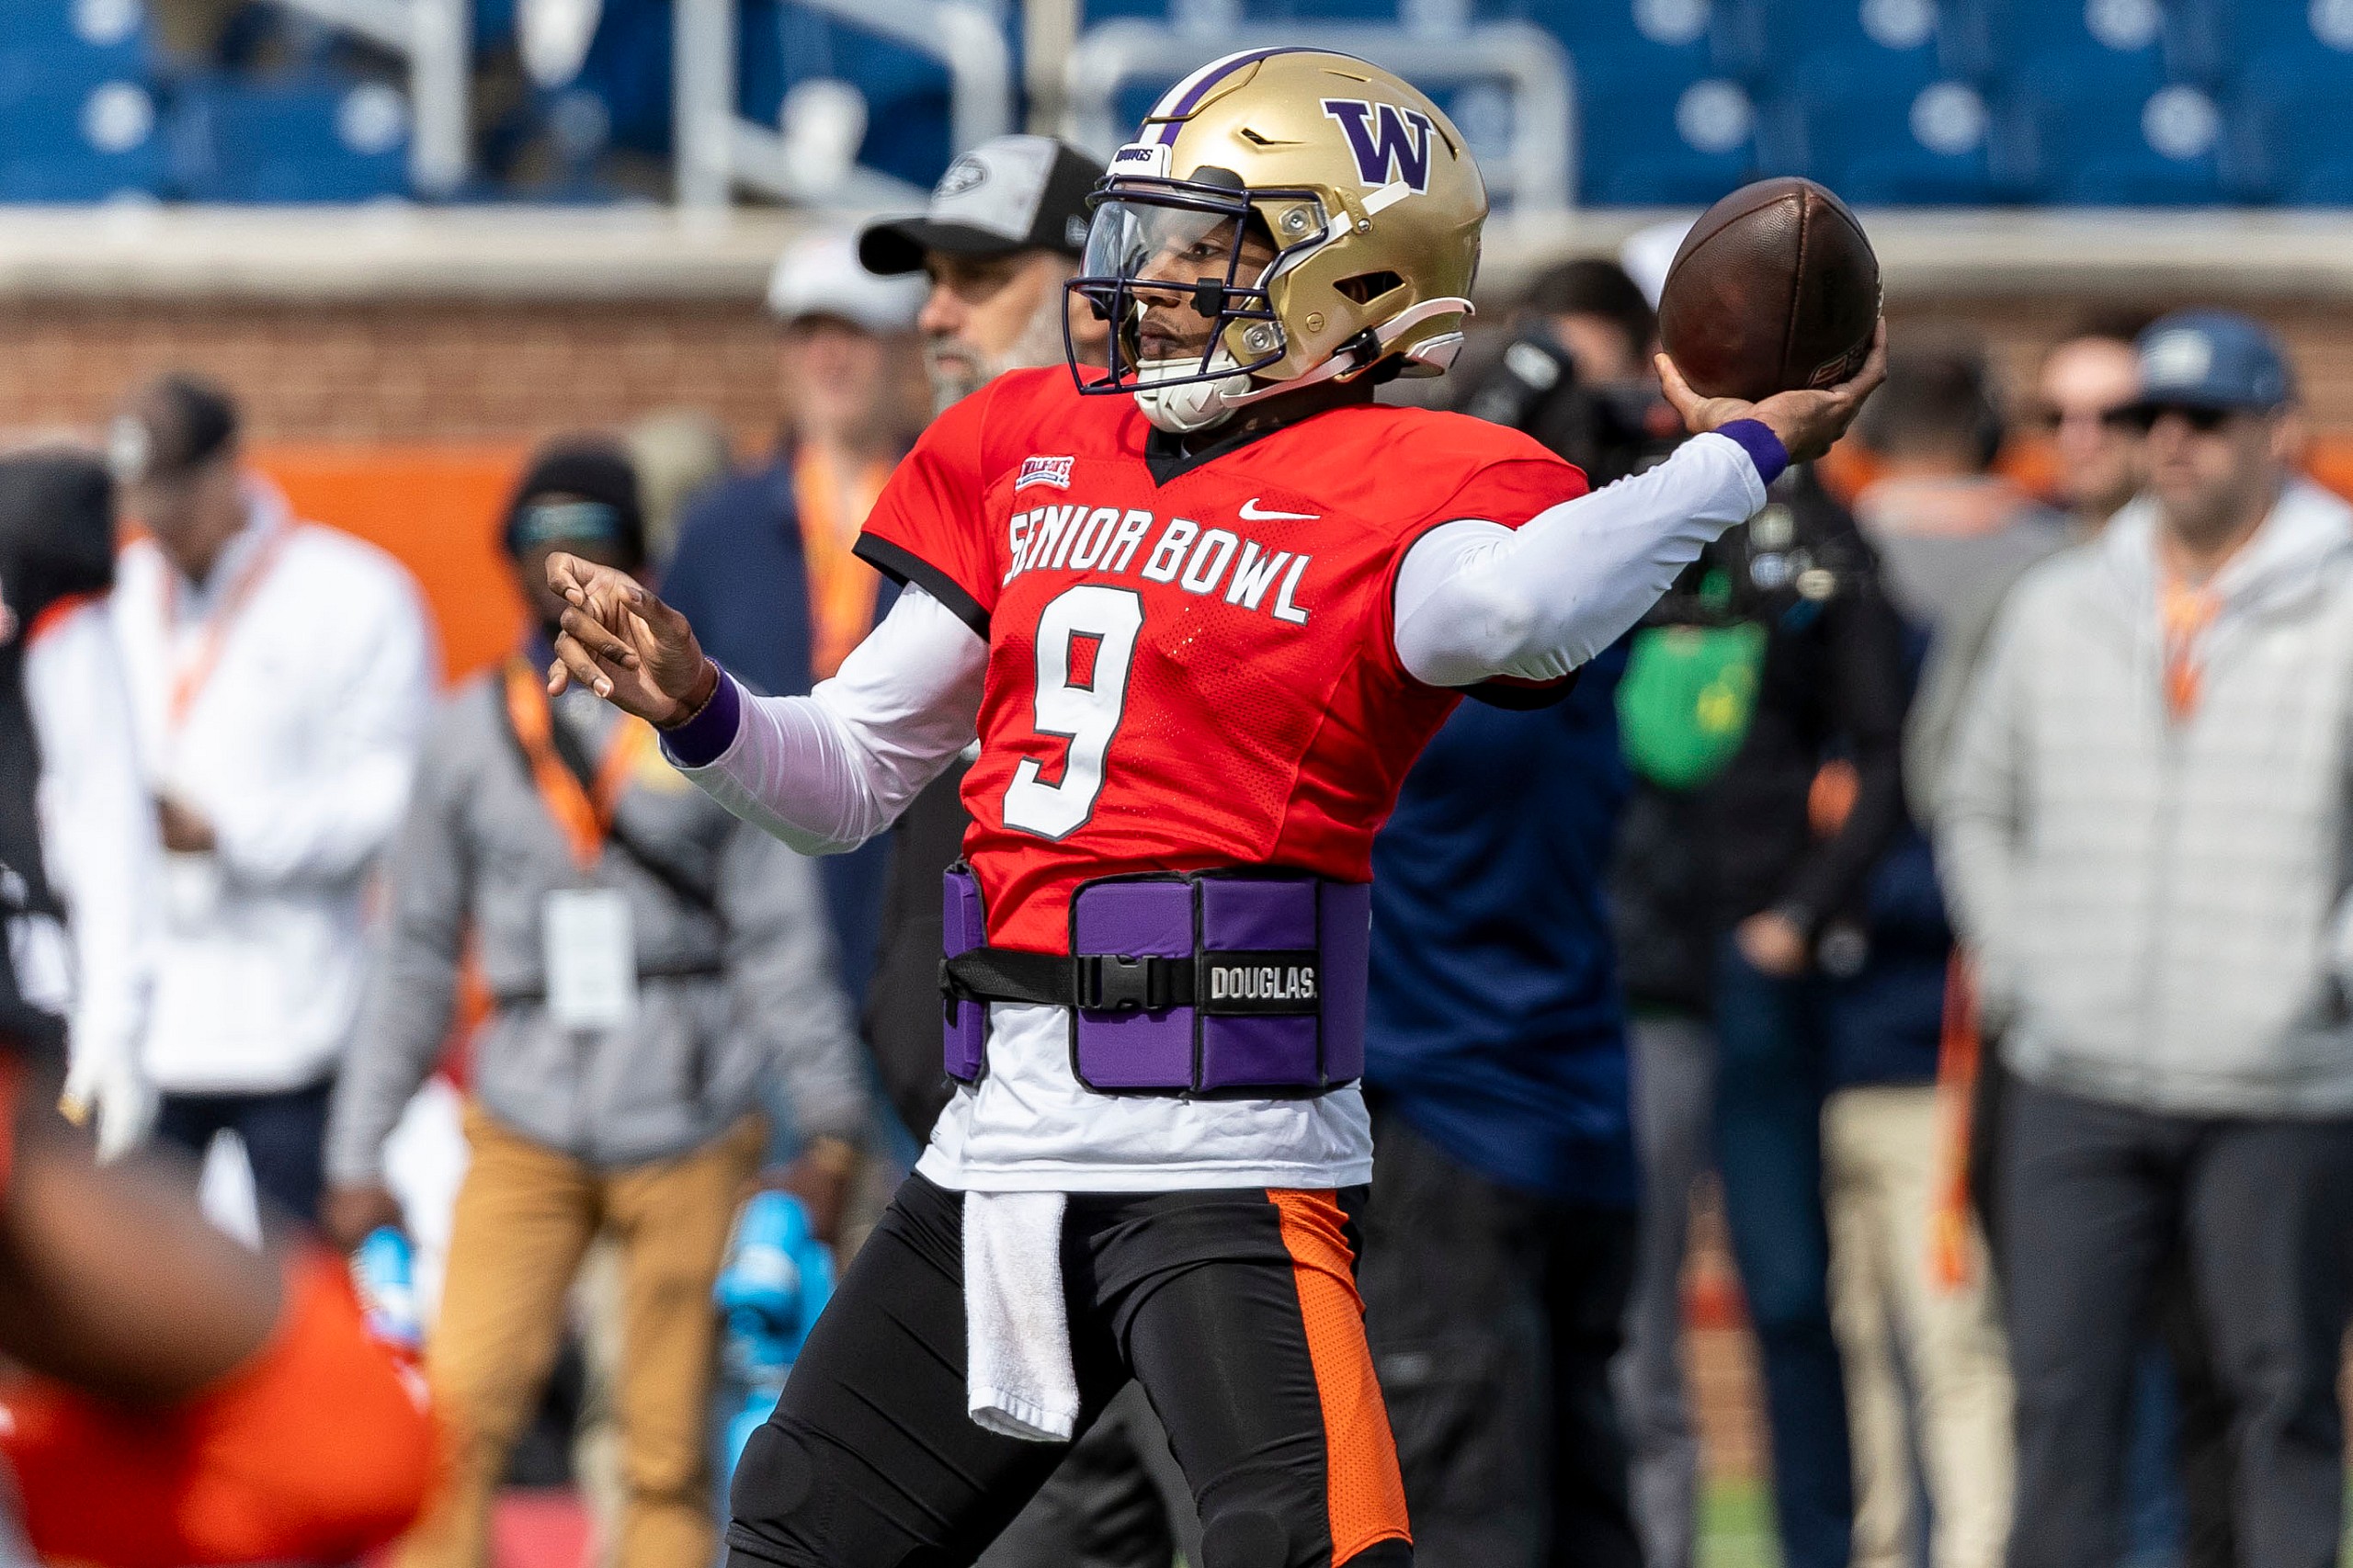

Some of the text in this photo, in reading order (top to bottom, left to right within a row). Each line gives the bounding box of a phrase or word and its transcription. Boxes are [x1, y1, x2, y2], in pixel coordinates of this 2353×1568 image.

[1320, 98, 1438, 195] W
[1002, 505, 1312, 626] SENIOR BOWL
[1003, 584, 1144, 841] 9
